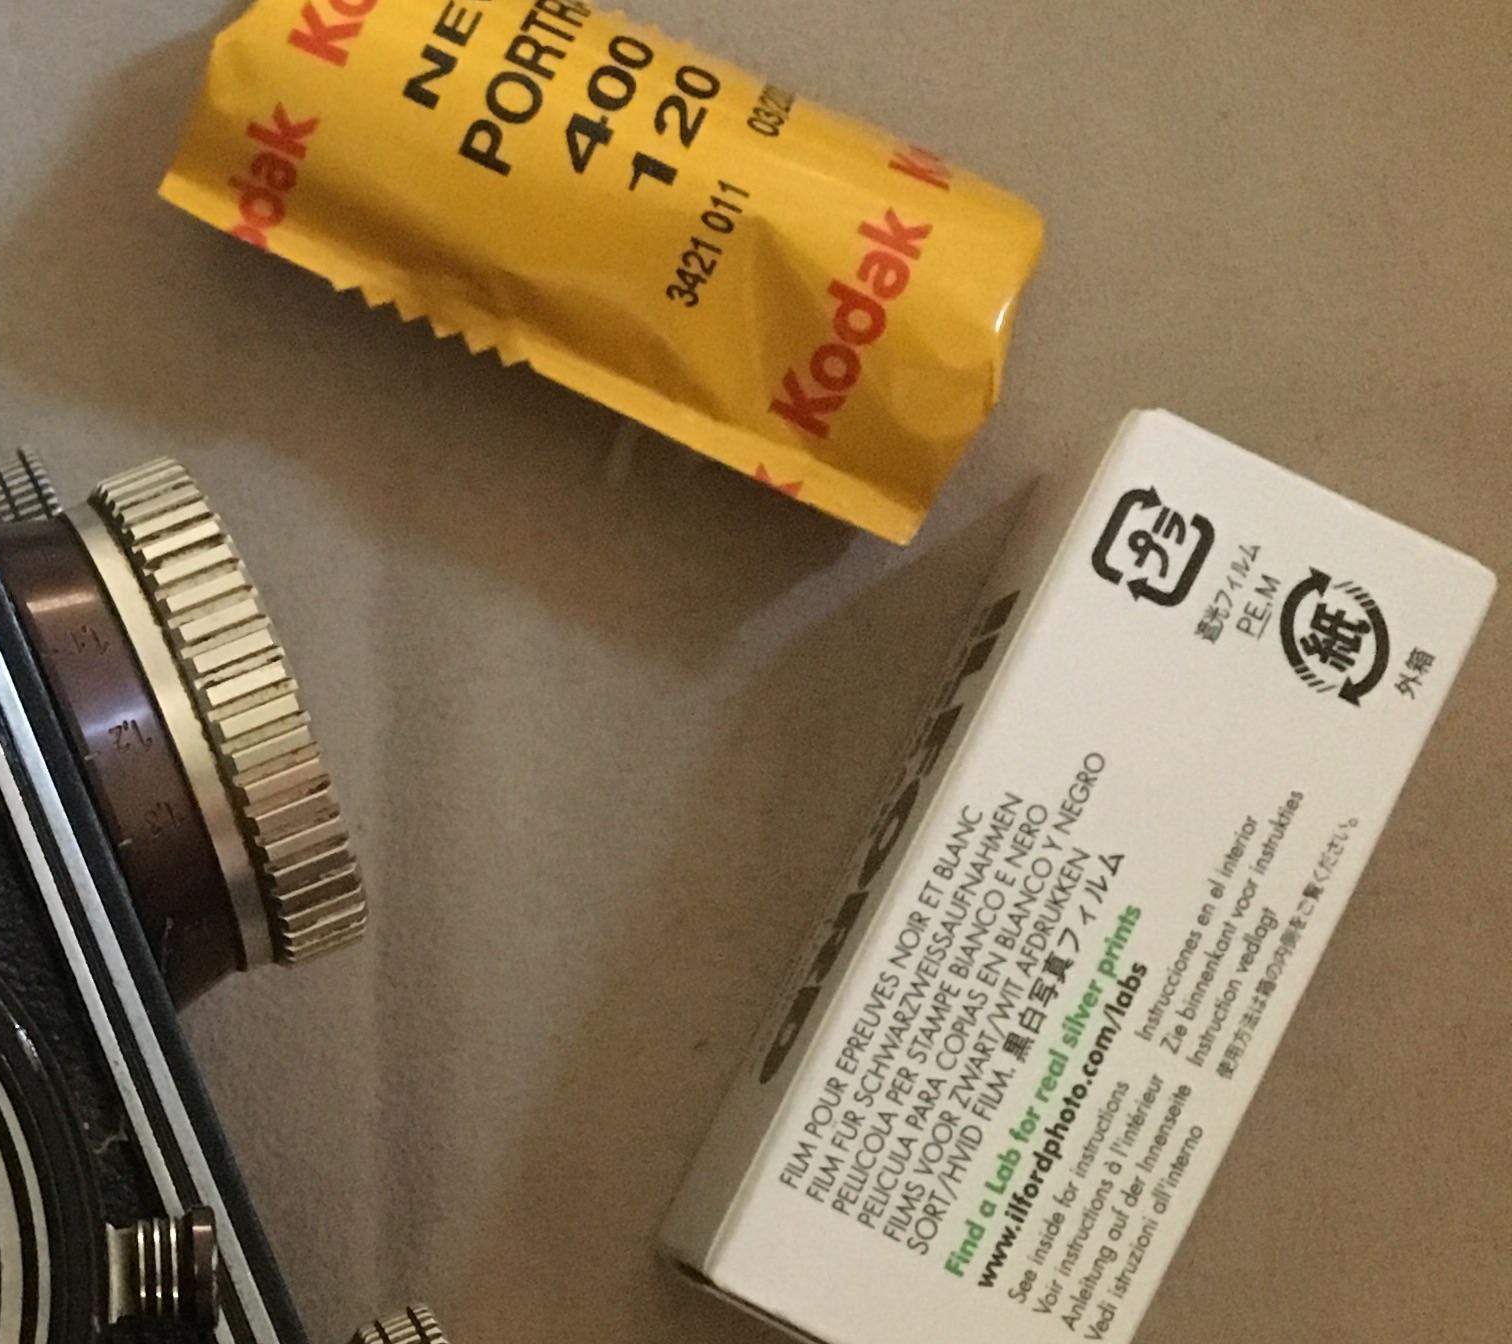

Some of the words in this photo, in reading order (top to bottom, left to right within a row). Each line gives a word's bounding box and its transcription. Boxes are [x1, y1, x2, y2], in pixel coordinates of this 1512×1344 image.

[565, 35, 655, 174] 400
[627, 66, 722, 188] 120
[666, 239, 722, 308] 3421
[700, 179, 749, 234] 011
[769, 208, 933, 438] Kodak
[1127, 506, 1186, 578] プラ
[1299, 602, 1372, 673] 紙
[1394, 646, 1435, 699] 外箱
[759, 591, 1021, 1084] ILFORD
[994, 869, 1016, 887] E
[1003, 803, 1048, 868] NERO
[947, 888, 1005, 979] BIANCO
[1096, 904, 1141, 979] prints
[1133, 929, 1203, 1041] Instrucciones
[1196, 902, 1215, 926] en
[1207, 878, 1225, 899] el
[1220, 814, 1257, 878] interior
[1159, 1023, 1188, 1054] Zie
[1175, 920, 1237, 1021] binnenkant
[1231, 877, 1258, 918] voor
[1249, 790, 1304, 874] instrukties
[779, 1140, 817, 1189] FILM
[803, 1076, 848, 1138] POUR
[835, 971, 900, 1075] EPREUVES
[888, 910, 931, 969] NOIR
[917, 879, 943, 909] ET
[932, 804, 983, 880] BLANC
[805, 1154, 844, 1203] FILM
[830, 1109, 866, 1151] FÜR
[853, 791, 1023, 1107] SCHWARZWEISSAUFNAHMEN
[856, 1136, 918, 1229] PELICULA
[904, 1077, 947, 1130] PARA
[935, 988, 988, 1071] COPIAS
[975, 951, 1007, 987] EN
[993, 856, 1053, 950] BLANCO
[1041, 834, 1062, 850] Y
[1052, 751, 1105, 835] NEGRO
[906, 980, 961, 1064] STAMPE
[1061, 978, 1103, 1048] silver
[1185, 978, 1242, 1067] Instruction
[1235, 906, 1279, 972] vedlagt
[882, 1180, 926, 1242] FILMS
[912, 1109, 961, 1175] VOOR
[947, 976, 1033, 1109] ZWART/WIT
[1015, 846, 1091, 978] AFDRUKKEN
[884, 1066, 919, 1106] PER
[906, 1124, 983, 1255] SORT/HVID
[971, 1068, 1015, 1121] FILM.
[1001, 853, 1125, 1063] 黒白写真フィルム
[1034, 1047, 1069, 1103] real
[831, 1111, 899, 1215] PELLICOLA
[977, 961, 1147, 1287] www.ilfordphoto.com/labs
[1008, 1105, 1040, 1143] for
[1109, 1073, 1164, 1157] l'intérieur
[979, 1198, 997, 1218] a
[984, 1148, 1022, 1195] Lab
[1007, 1268, 1038, 1304] See
[1032, 1211, 1065, 1265] inside
[1052, 1180, 1079, 1208] for
[1069, 1080, 1130, 1178] instructions
[1060, 1244, 1118, 1331] Anleitung
[1107, 1205, 1129, 1241] auf
[1119, 1175, 1145, 1207] der
[1135, 1084, 1192, 1172] Innenseite
[1103, 1160, 1123, 1175] à
[944, 1218, 986, 1277] Find
[1058, 1178, 1114, 1277] instructions
[1083, 1302, 1117, 1340] Vedi
[1107, 1215, 1158, 1299] istruzioni
[1151, 1125, 1203, 1214] all'interno
[1031, 1278, 1063, 1313] Voir
